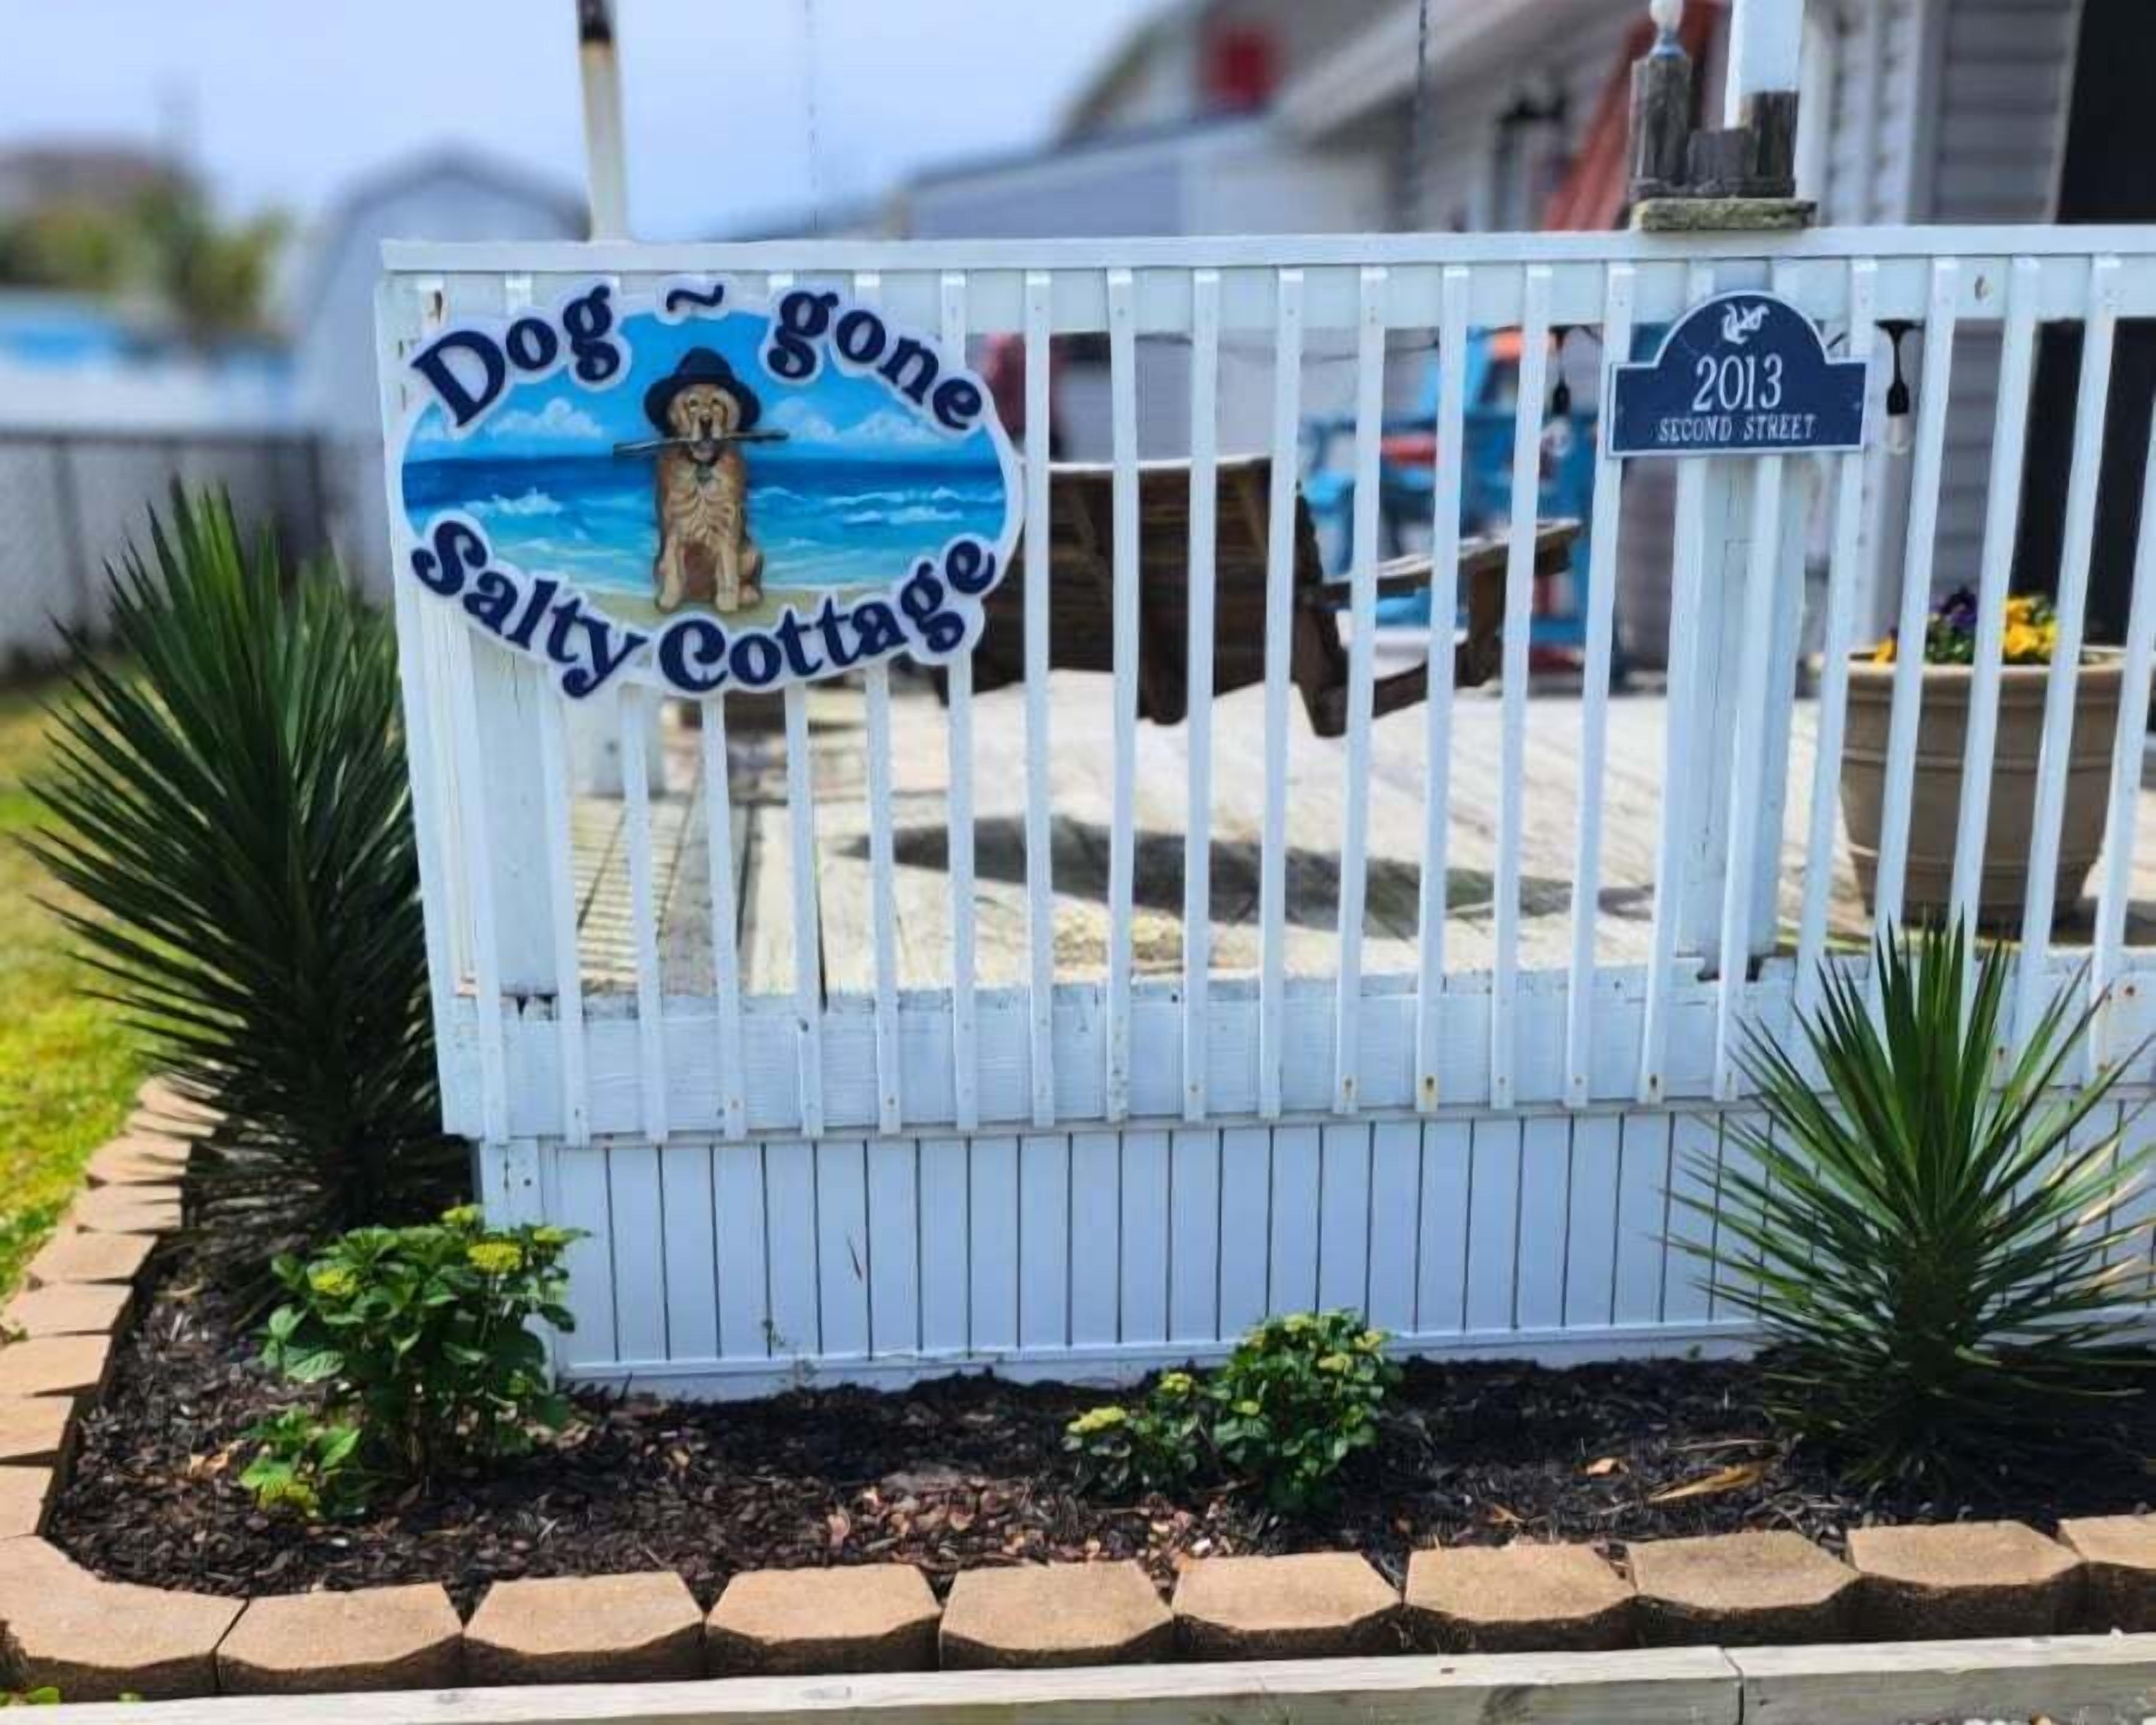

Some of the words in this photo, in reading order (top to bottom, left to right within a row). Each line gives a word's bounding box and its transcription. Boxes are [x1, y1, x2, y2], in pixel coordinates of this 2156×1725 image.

[413, 285, 620, 426] Dog
[766, 291, 982, 429] gone
[1692, 354, 1783, 411] 2013
[1658, 417, 1733, 442] SECOND
[1743, 414, 1816, 441] STREET
[411, 520, 649, 698] Salty
[658, 540, 996, 691] Cottage
